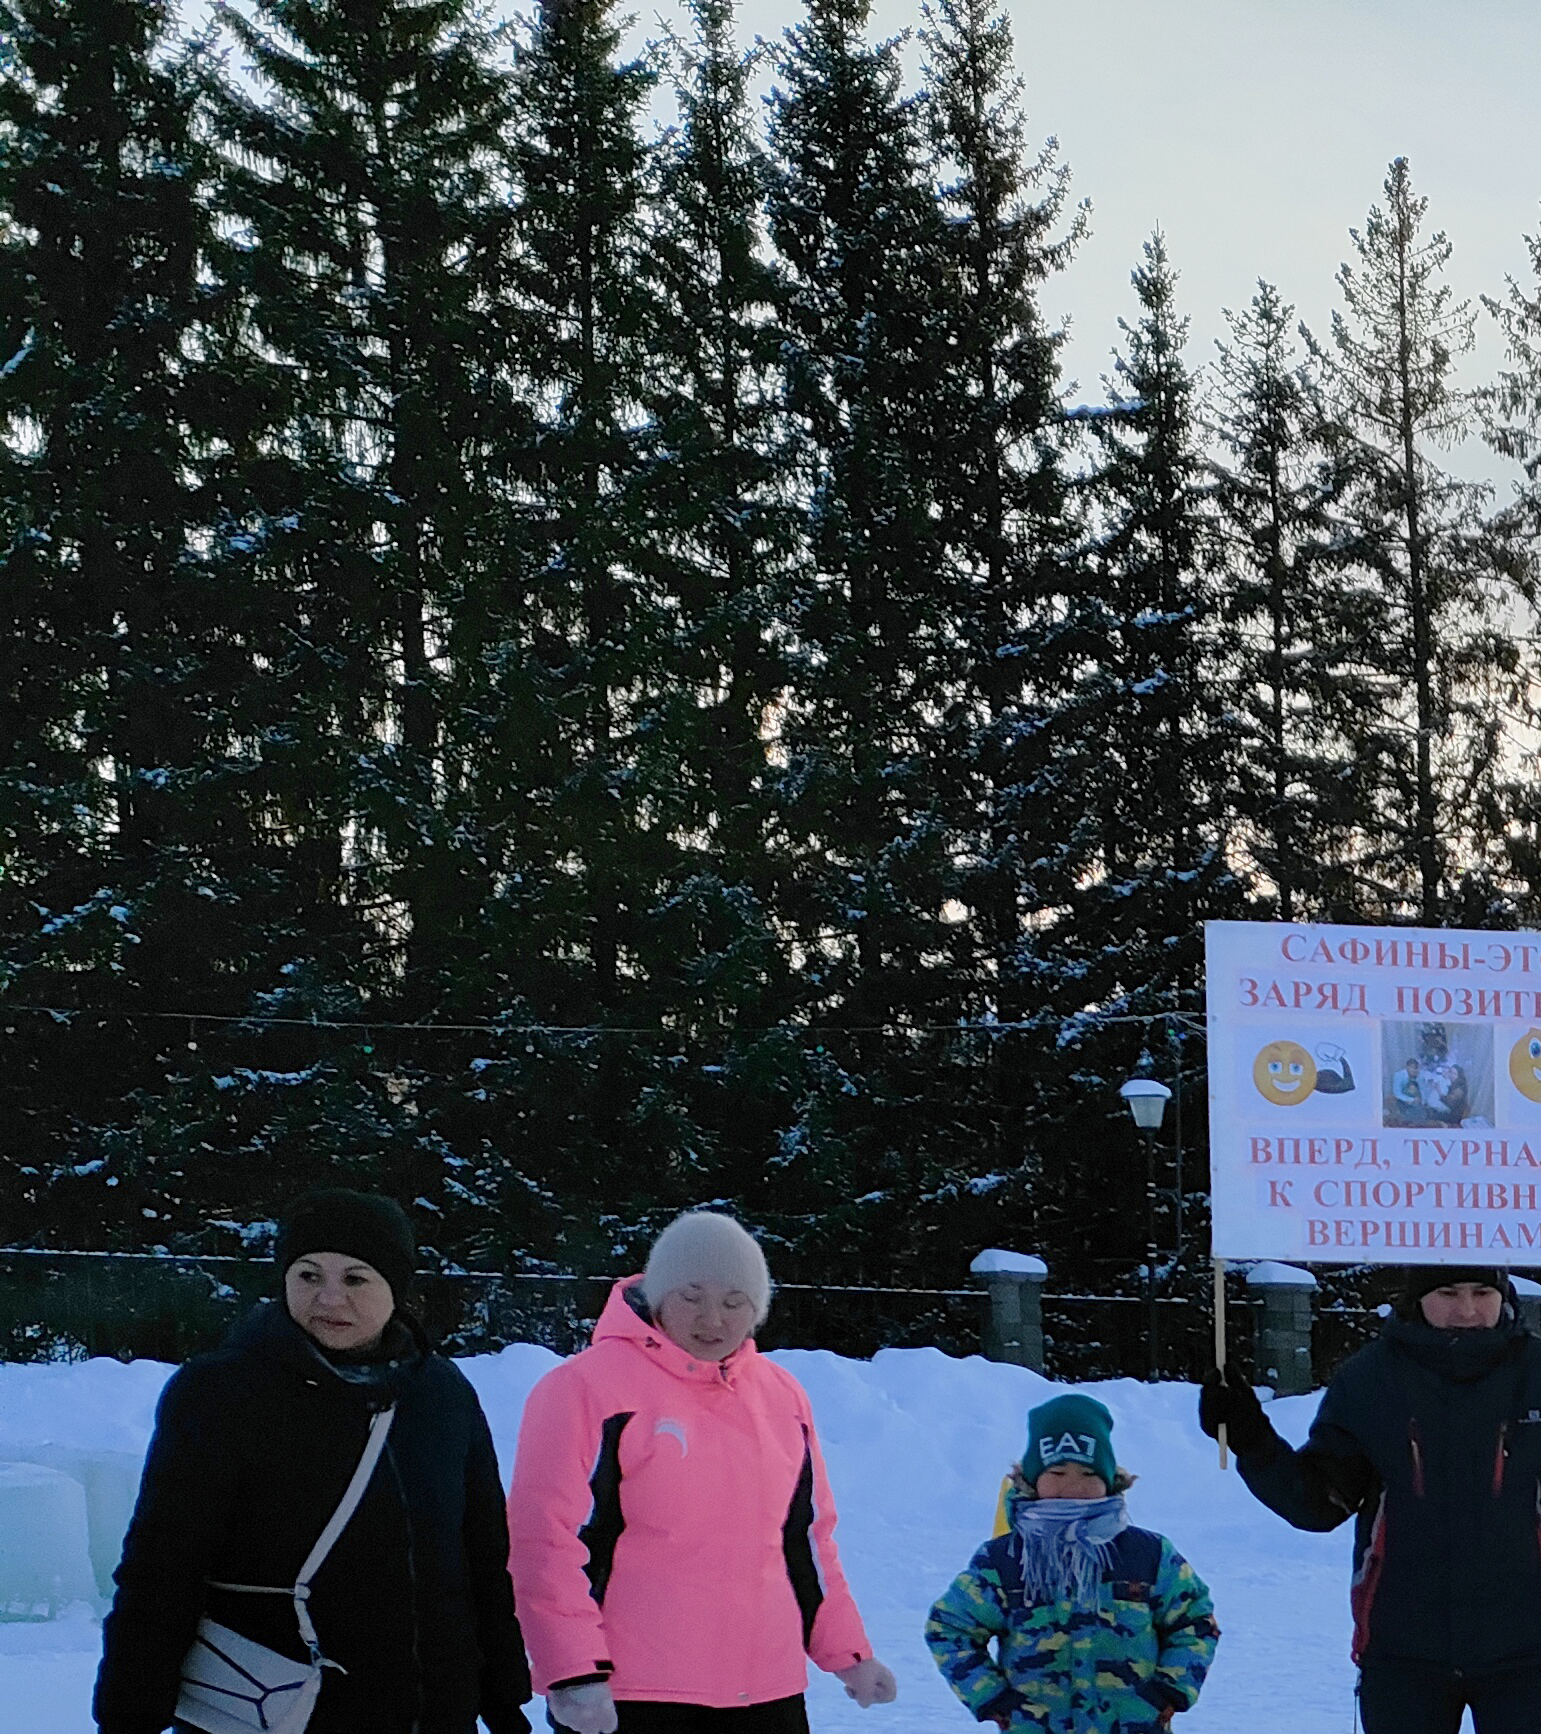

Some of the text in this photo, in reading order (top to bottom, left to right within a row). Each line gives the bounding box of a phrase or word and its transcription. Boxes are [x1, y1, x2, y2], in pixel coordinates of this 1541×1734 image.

[1239, 977, 1370, 1017] ЗАРЯД
[1249, 1135, 1392, 1171] ВПЕРД,
[1267, 1179, 1294, 1207] К
[1039, 1431, 1097, 1459] EA7
